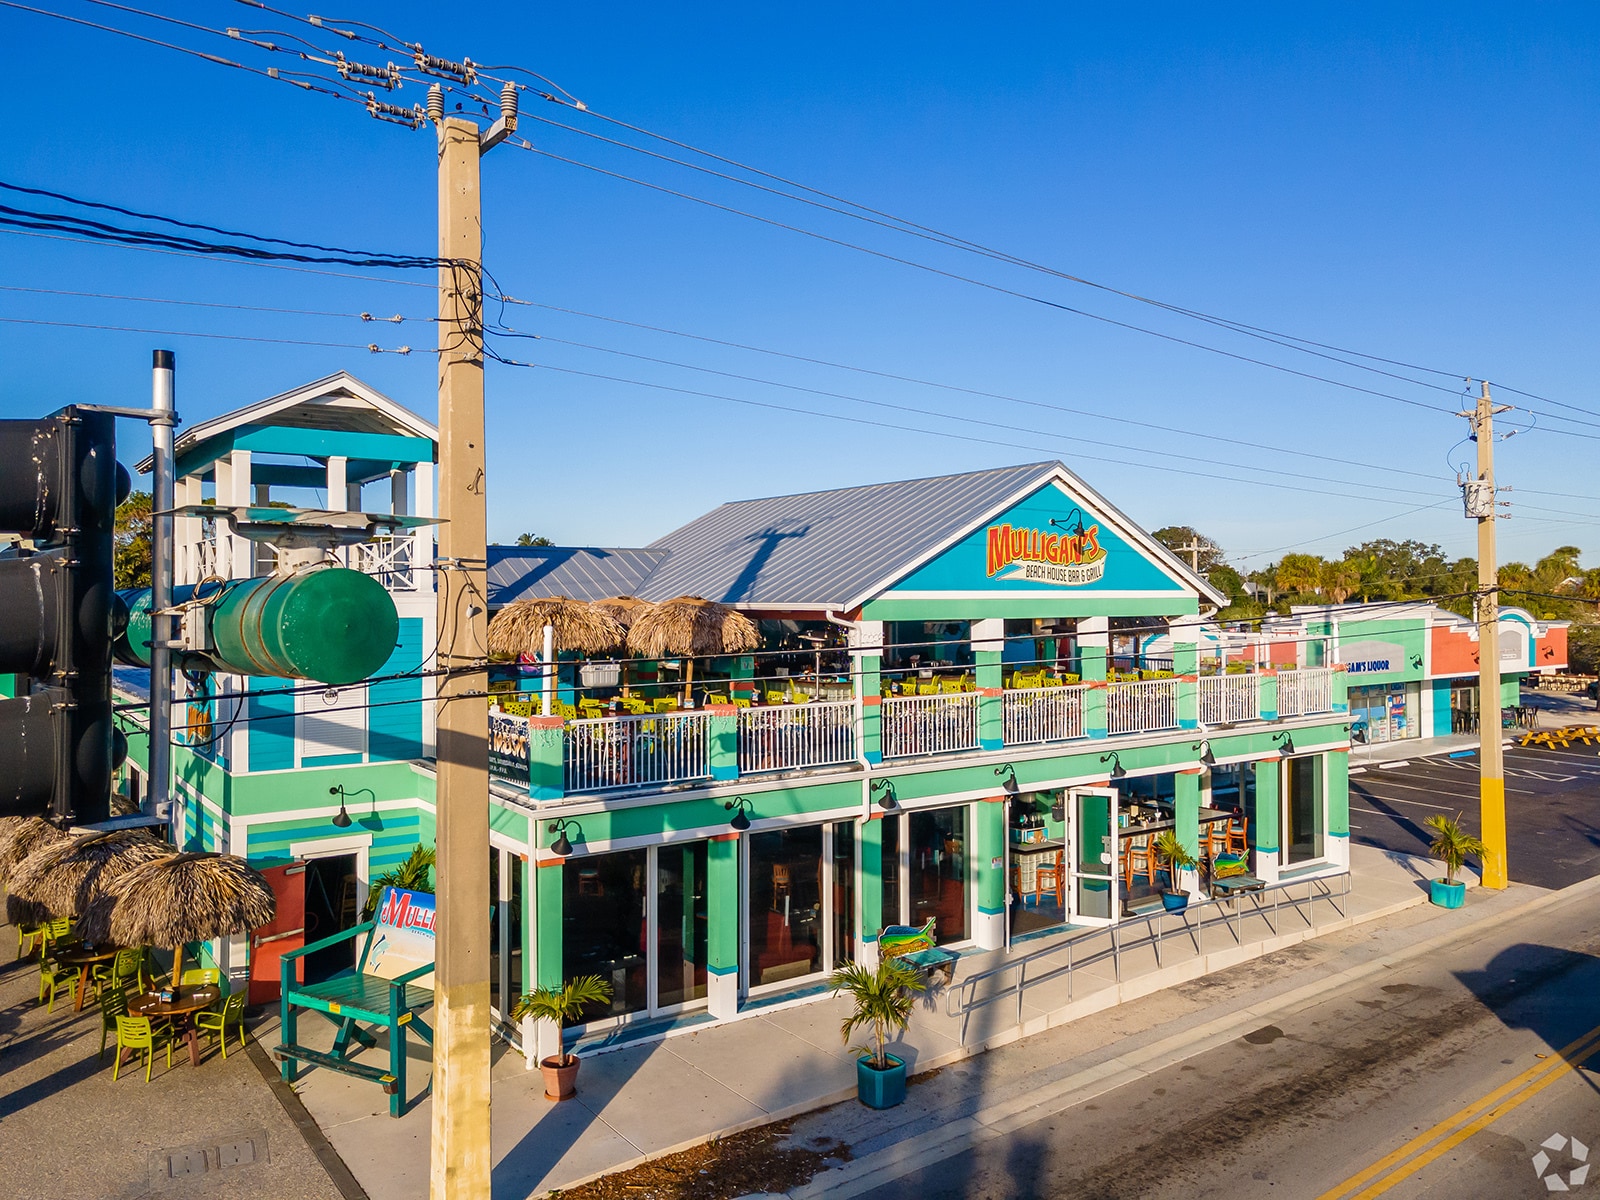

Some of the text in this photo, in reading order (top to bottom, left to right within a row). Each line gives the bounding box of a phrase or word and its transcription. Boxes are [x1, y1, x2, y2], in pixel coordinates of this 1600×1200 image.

[987, 524, 1098, 577] MULLIGAN'S
[1025, 564, 1046, 578] BEACH
[1046, 566, 1067, 582] HOUSE
[1068, 569, 1080, 583] BAR
[1086, 565, 1102, 581] GRILL
[1347, 660, 1389, 673] SAM'S LIQUOR
